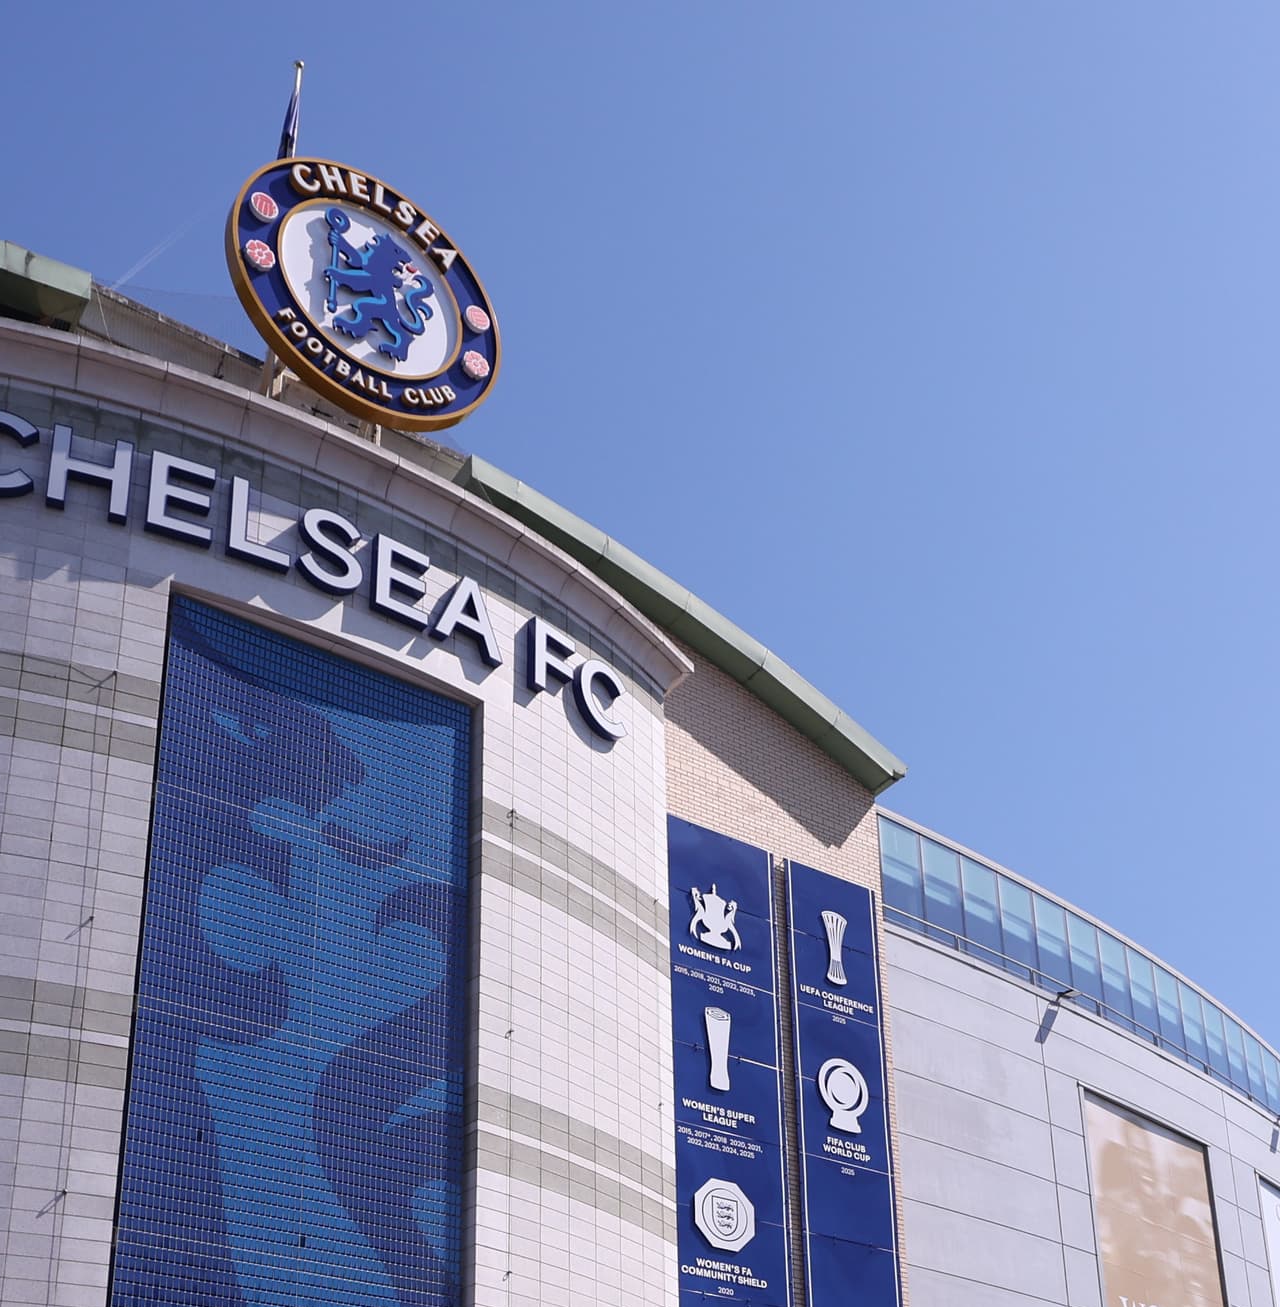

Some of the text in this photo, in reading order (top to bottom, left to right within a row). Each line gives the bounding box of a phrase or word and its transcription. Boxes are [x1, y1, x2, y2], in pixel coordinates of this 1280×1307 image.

[290, 163, 458, 273] CHELSEA
[273, 307, 457, 408] FOOTBALL CLUB
[528, 616, 628, 742] FC
[678, 943, 752, 973] WOMEN'S FA CUP
[800, 984, 874, 1014] UEFA CONFERENCE
[823, 999, 854, 1015] LEAGUE
[682, 1098, 756, 1125] WOMEN'S SUPER
[702, 1113, 738, 1129] LEAGUE
[822, 1143, 871, 1163] WORLD CUP
[826, 1136, 867, 1153] FIFA CLUB
[681, 1264, 768, 1289] COMMUNITY SHIELD
[696, 1257, 753, 1276] WOMEN'S FA
